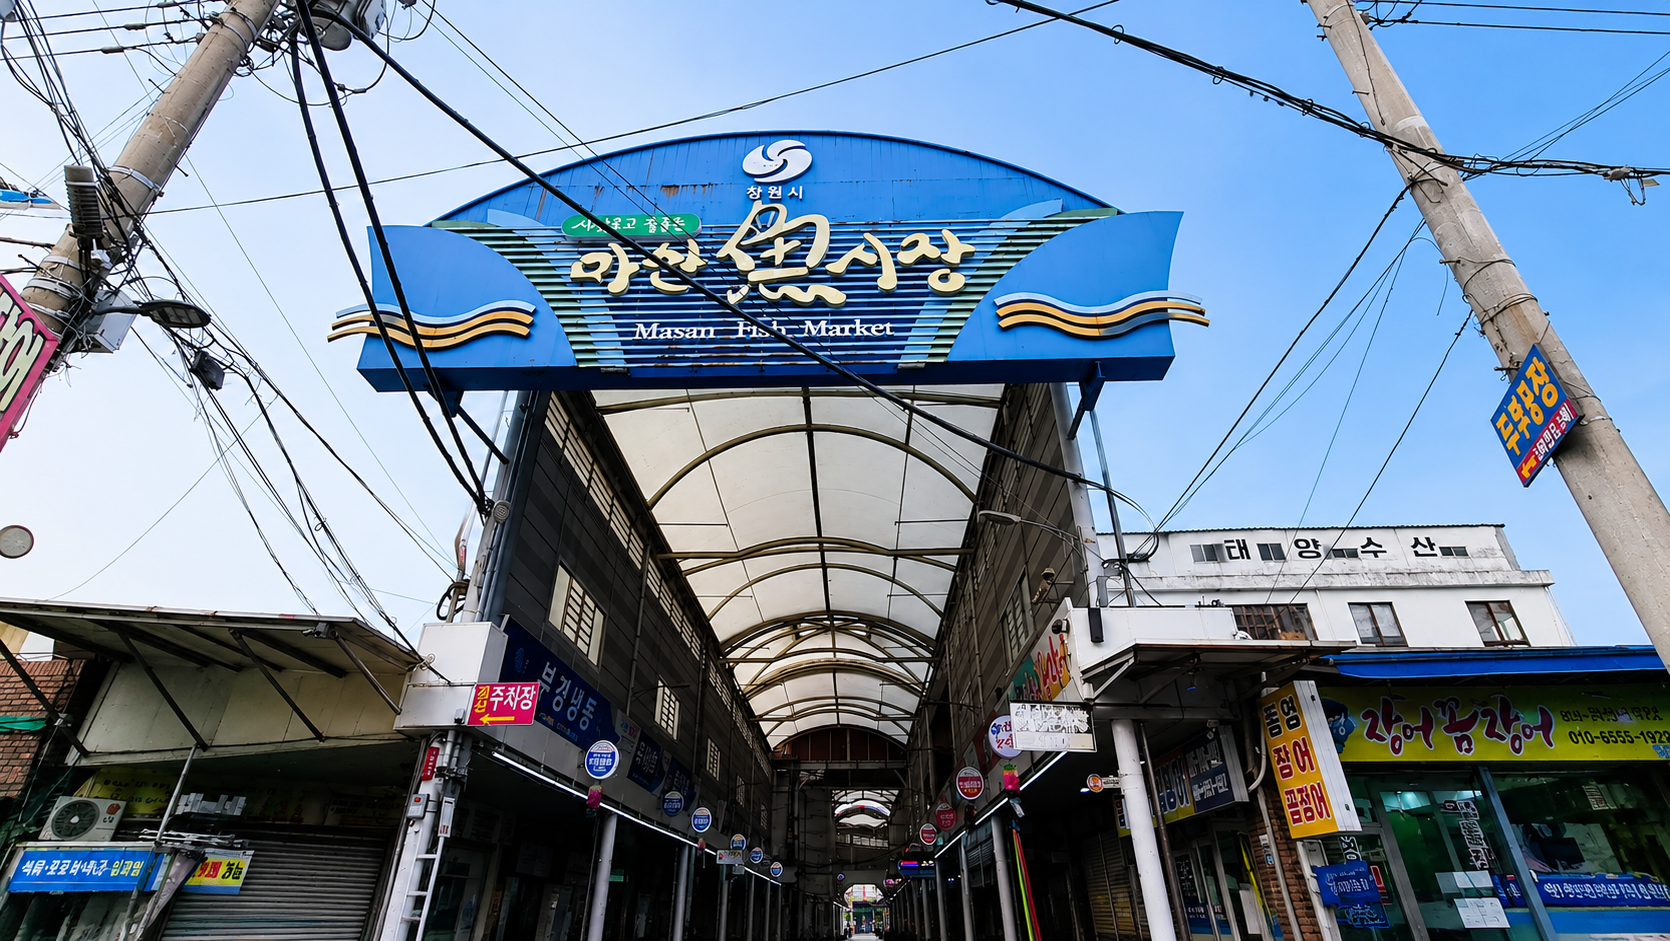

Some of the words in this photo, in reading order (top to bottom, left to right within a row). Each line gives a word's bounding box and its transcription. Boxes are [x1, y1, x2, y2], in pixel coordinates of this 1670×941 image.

[746, 185, 803, 200] 창원시
[632, 322, 716, 340] Masan
[736, 320, 787, 340] Fish
[803, 318, 896, 338] Market
[1223, 536, 1438, 560] 태양수산
[490, 684, 537, 712] 주차장
[536, 660, 598, 732] 부경냉동
